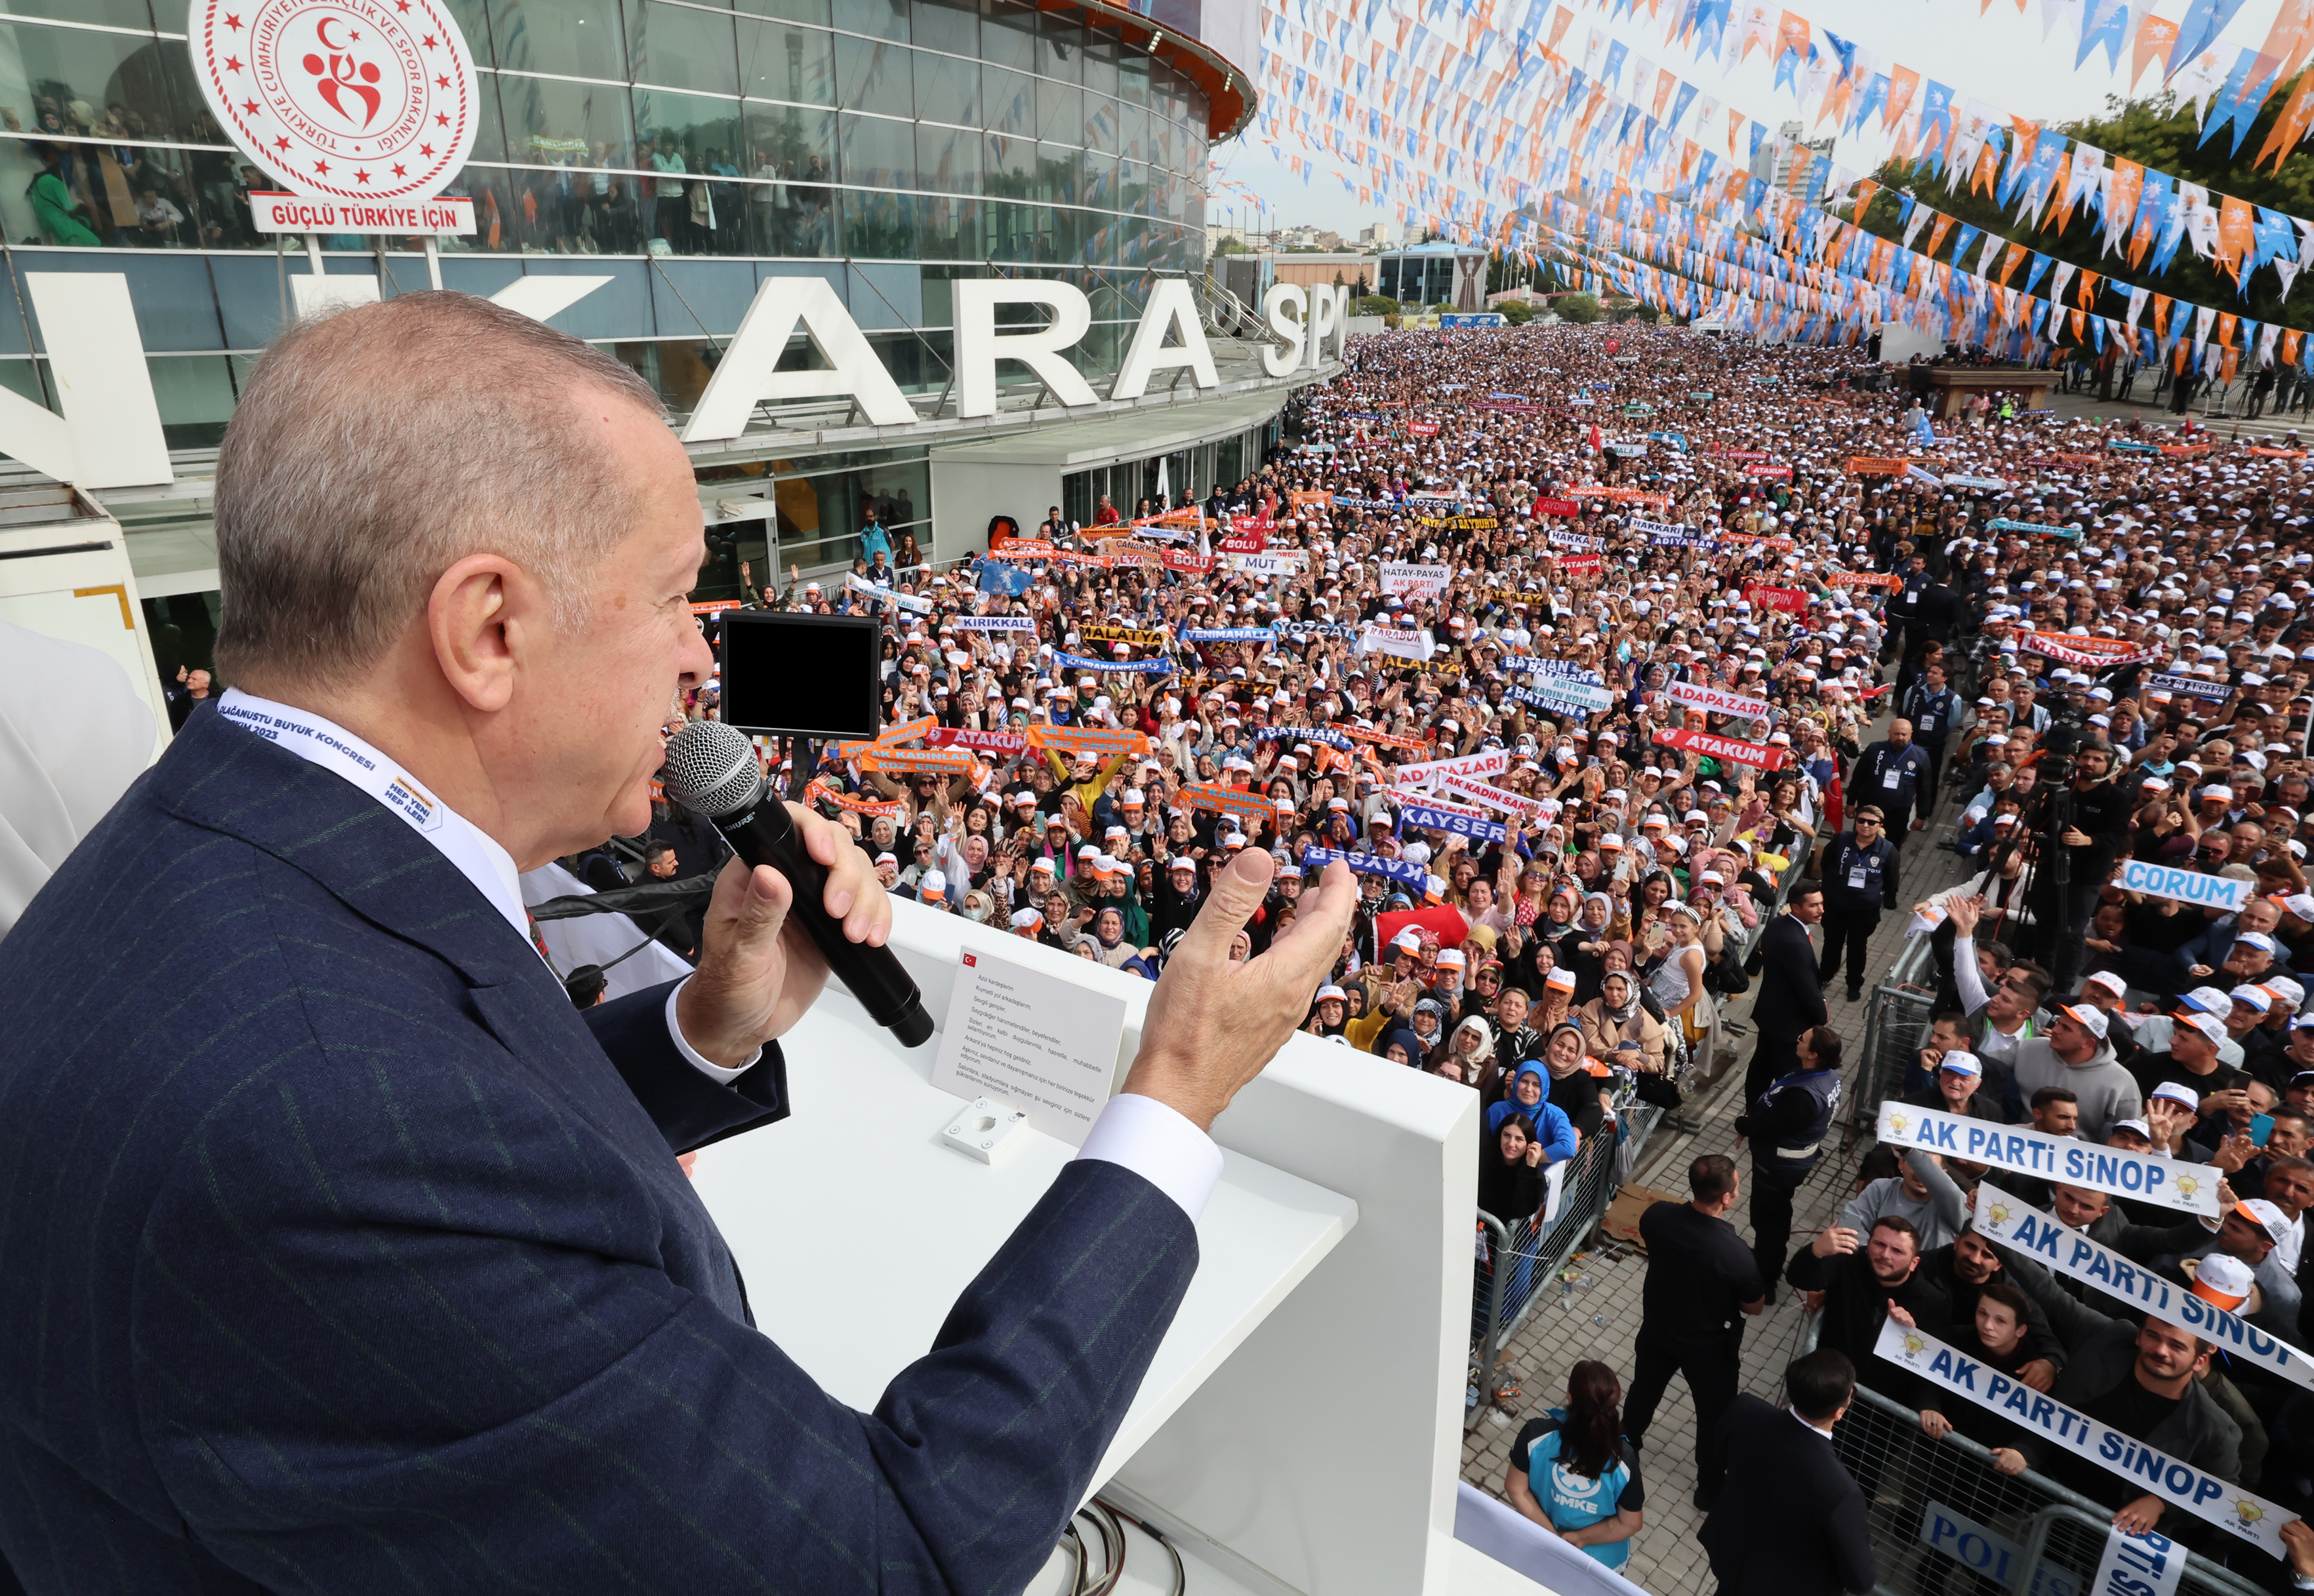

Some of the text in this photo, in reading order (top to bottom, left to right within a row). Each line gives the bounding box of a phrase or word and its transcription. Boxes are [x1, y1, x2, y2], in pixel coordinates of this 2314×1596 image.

[380, 16, 399, 38] VE
[396, 39, 421, 81] SPOR
[274, 96, 336, 150] TÜRKİYE
[377, 85, 423, 151] BAKANLIĞI
[272, 202, 457, 231] GÜÇLÜ TÜRKİYE İÇİN
[1753, 466, 1788, 475] ATAKUM
[1349, 498, 1396, 510] YOZGAT
[1410, 498, 1456, 509] YOZGAT
[1543, 500, 1568, 511] AYDIN
[1226, 539, 1257, 550] BOLU
[1655, 537, 1714, 548] ADIYAMAN
[1054, 551, 1105, 565] ALIKESİR
[1173, 554, 1209, 569] BOLU
[1246, 557, 1277, 570] MUT
[1383, 568, 1444, 578] HATAY-PAYAS
[964, 617, 1033, 629] KIRIKKALE
[1278, 621, 1350, 637] YOZGAT
[1079, 626, 1166, 644] MALATYA
[1066, 657, 1159, 672] KAHRAMANMARAŞ
[2186, 680, 2232, 697] AKSARAY
[1532, 686, 1608, 710] KADIN KOLLARI
[1670, 686, 1766, 715] ADAPAZARI
[253, 725, 279, 740] 2023
[1040, 727, 1137, 740] AK KADINLAR
[1267, 727, 1340, 744] BATMAN
[274, 718, 316, 737] BÜYÜK
[315, 732, 376, 771] KONGRESİ
[1685, 735, 1767, 763] ATAKUM
[871, 749, 971, 761] AK KADINLAR
[878, 761, 912, 770] KDZ.
[384, 789, 404, 806] HEP
[389, 782, 409, 799] HEP
[1184, 784, 1272, 805] AK KADINLA
[1445, 776, 1553, 822] AK KADIN SAMUN
[1402, 808, 1506, 842] KAYSER
[988, 978, 1014, 991] kardeşlerim
[973, 995, 988, 1005] Sevgili
[969, 1017, 983, 1027] Sizleri
[997, 1028, 1008, 1037] kalbi
[1072, 1058, 1102, 1073] muhabbetle
[987, 1043, 1004, 1054] hepiniz
[1004, 1050, 1012, 1059] hoş
[1047, 1079, 1056, 1088] her
[981, 1072, 1009, 1088] stadyumlara
[1042, 1098, 1063, 1110] sevginiz
[1063, 1106, 1072, 1115] için
[1074, 1111, 1091, 1122] sizlere
[1916, 1117, 1959, 1150] AK
[2011, 1213, 2065, 1260] AK
[1894, 1353, 1905, 1362] AK
[1928, 1348, 1980, 1393] AK
[2223, 1519, 2236, 1528] AK
